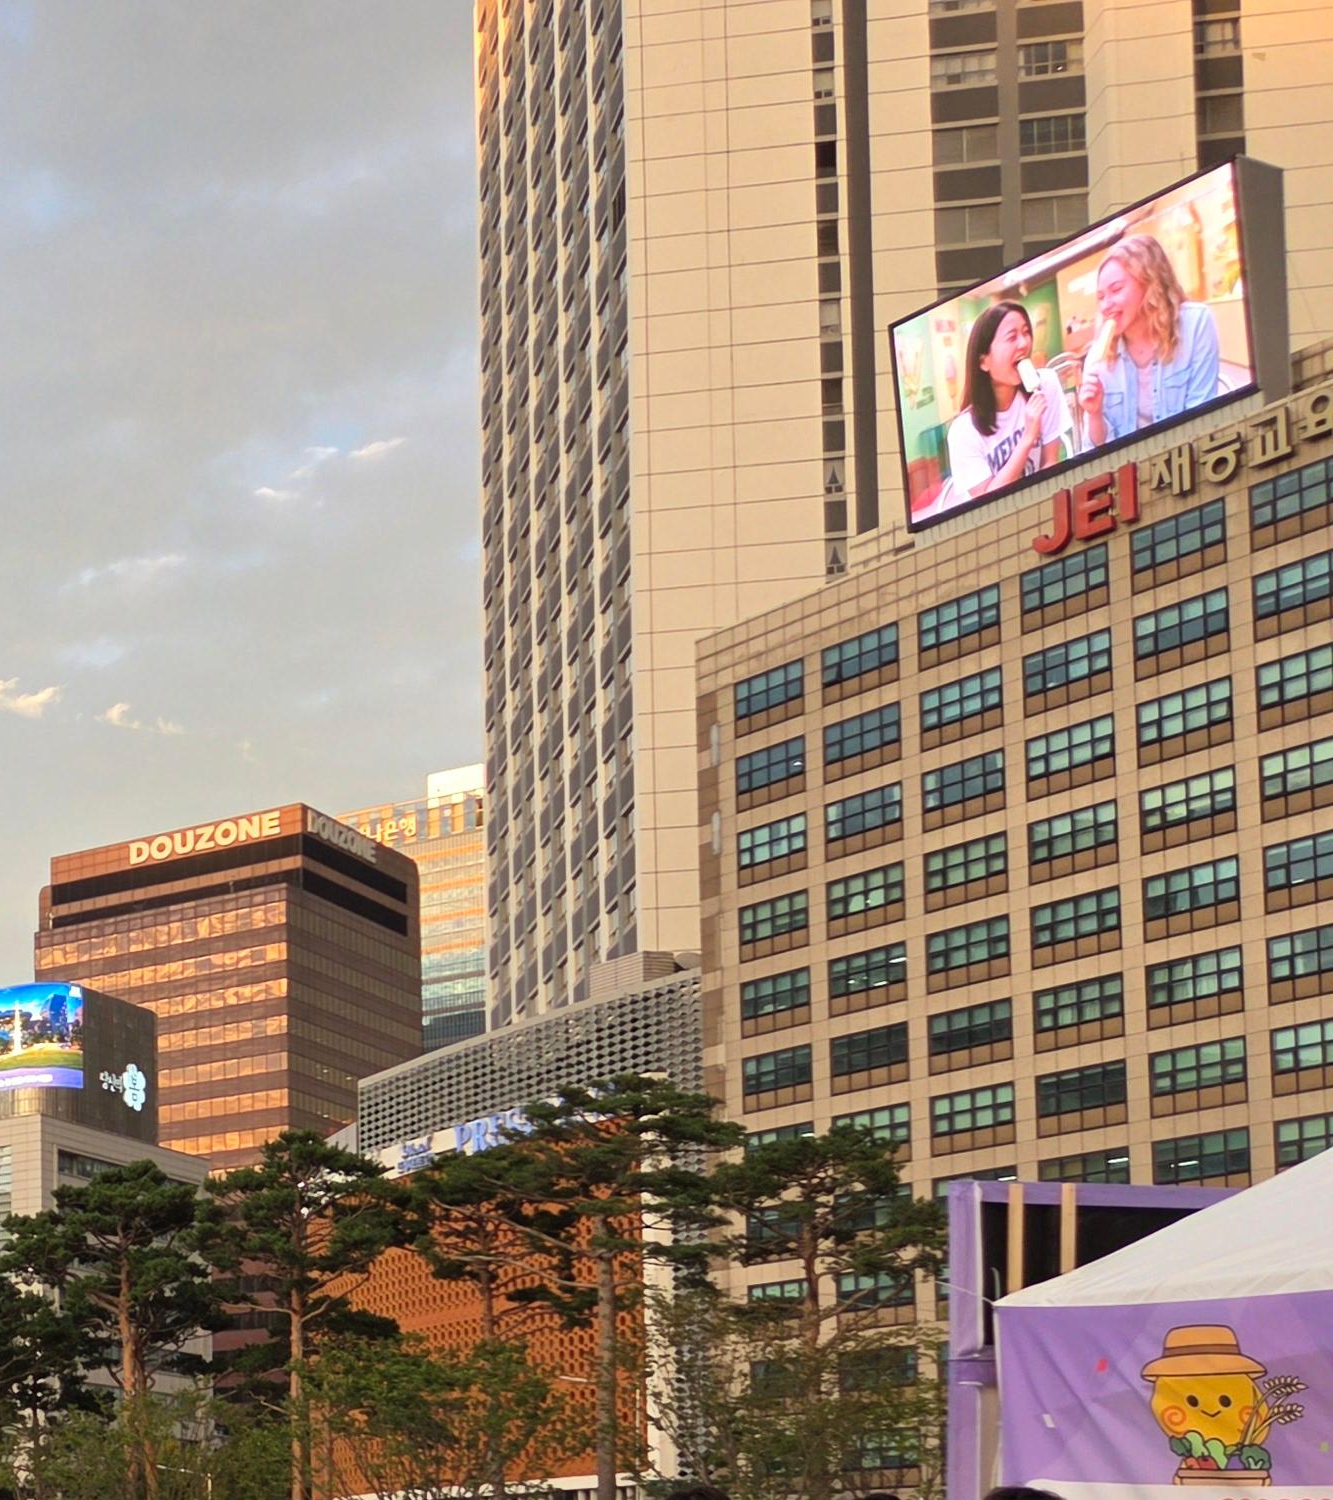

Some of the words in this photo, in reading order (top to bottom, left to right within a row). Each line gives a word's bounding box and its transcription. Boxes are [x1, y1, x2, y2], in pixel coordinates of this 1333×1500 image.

[1033, 460, 1139, 555] JEI
[129, 810, 281, 865] DOUZONE
[307, 809, 376, 863] DOUZONE
